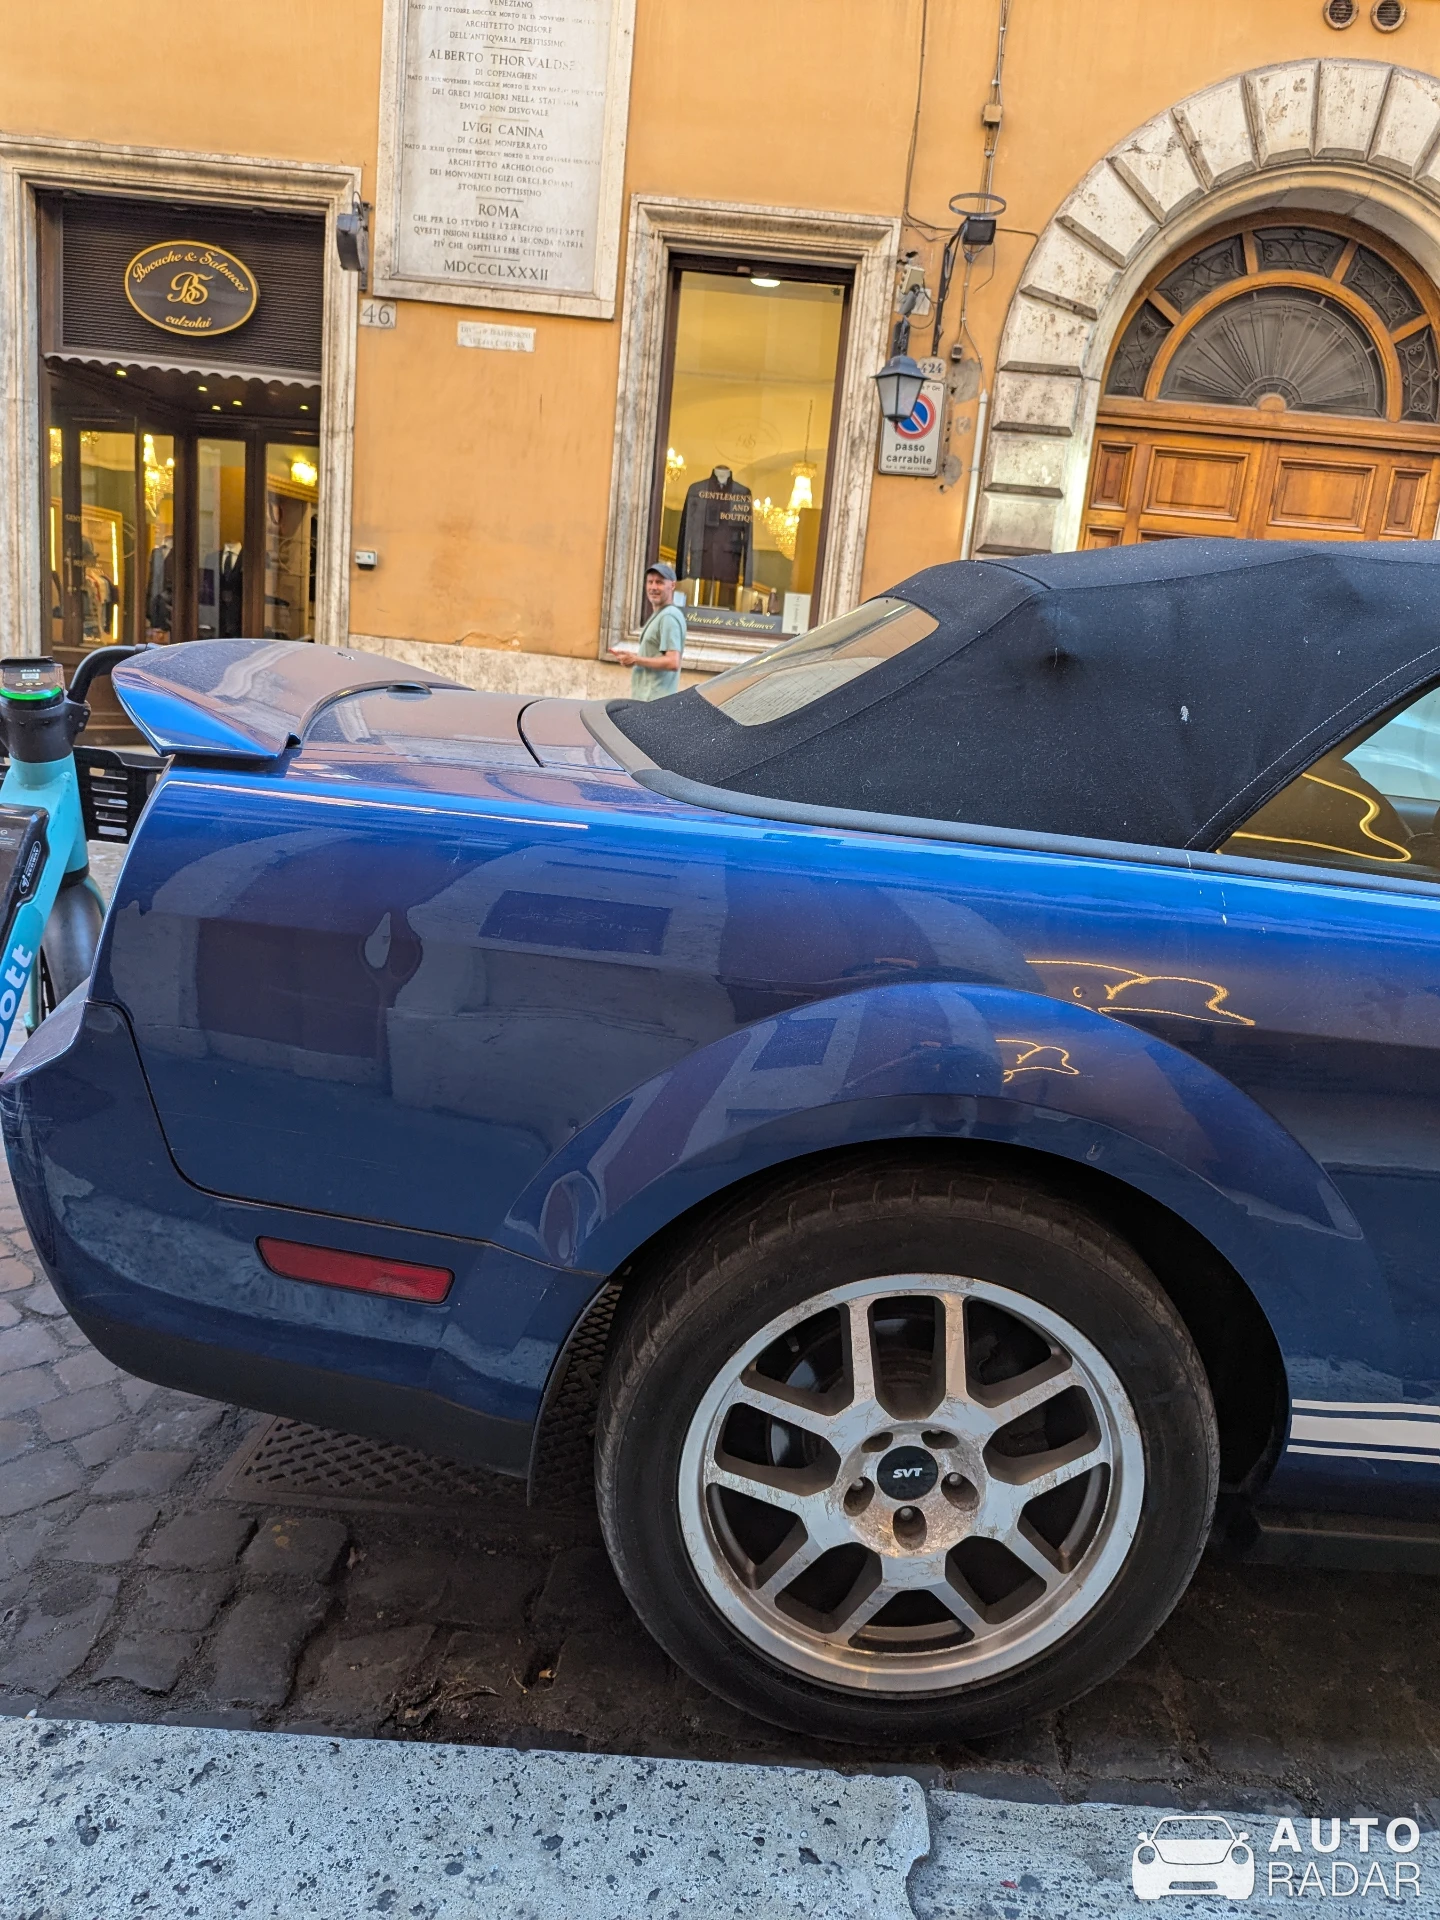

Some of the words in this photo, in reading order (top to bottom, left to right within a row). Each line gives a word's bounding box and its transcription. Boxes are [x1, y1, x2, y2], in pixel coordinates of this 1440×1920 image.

[489, 0, 533, 8] VENEZIANO
[465, 21, 514, 31] ARCHITETTO
[517, 24, 552, 34] INCISORE
[449, 31, 517, 44] DELL'ANTIQVARIA
[520, 37, 565, 48] PERITISSIMO
[428, 49, 483, 63] ALBERTO
[490, 53, 576, 71] THORVALDSE
[475, 68, 483, 76] DI
[486, 69, 537, 80] COPENAGHEN
[432, 88, 445, 96] DEI
[447, 89, 471, 98] GRECI
[474, 91, 508, 101] MIGLIORI
[511, 94, 535, 103] NELLA
[459, 102, 486, 111] EMVLO
[489, 104, 506, 112] NON
[509, 106, 549, 117] DISVGVALE
[462, 121, 492, 134] LVIGI
[498, 124, 544, 138] CANINA
[457, 136, 465, 144] DI
[468, 137, 491, 146] CASAL
[494, 139, 548, 151] MONFERRATO
[447, 158, 497, 169] ARCHITETTO
[501, 163, 554, 174] ARCHEOLOGO
[429, 168, 441, 176] DEI
[444, 170, 491, 181] MONVMENTI
[493, 174, 513, 183] EGIZI
[457, 183, 492, 193] STORICO
[495, 187, 542, 197] DOTTISSIMO
[478, 203, 519, 219] ROMA
[413, 214, 427, 223] CHE
[430, 216, 444, 224] PER
[447, 217, 457, 225] LO
[460, 218, 489, 228] STVDIO
[499, 222, 543, 233] L'ESERCIZIO
[413, 226, 441, 236] QVESTI
[443, 229, 470, 238] INSIGNI
[472, 231, 508, 242] ELESSERO
[519, 236, 554, 247] SECONDA
[557, 239, 583, 250] PATRIA
[448, 241, 463, 250] CHE
[467, 243, 491, 253] OSPITI
[503, 246, 520, 256] EBBE
[522, 248, 563, 259] CITTADINI
[132, 250, 183, 283] Bocache
[184, 251, 198, 263] &
[443, 259, 549, 281] MDCCCLXXXII
[165, 314, 213, 329] calzolai
[362, 303, 394, 325] 46
[920, 362, 943, 374] 424
[894, 443, 925, 453] passo
[886, 455, 932, 465] carrabile
[698, 490, 752, 503] GENTLEMEN'S
[732, 504, 750, 512] AND
[725, 618, 734, 626] &
[892, 1467, 923, 1479] SVT
